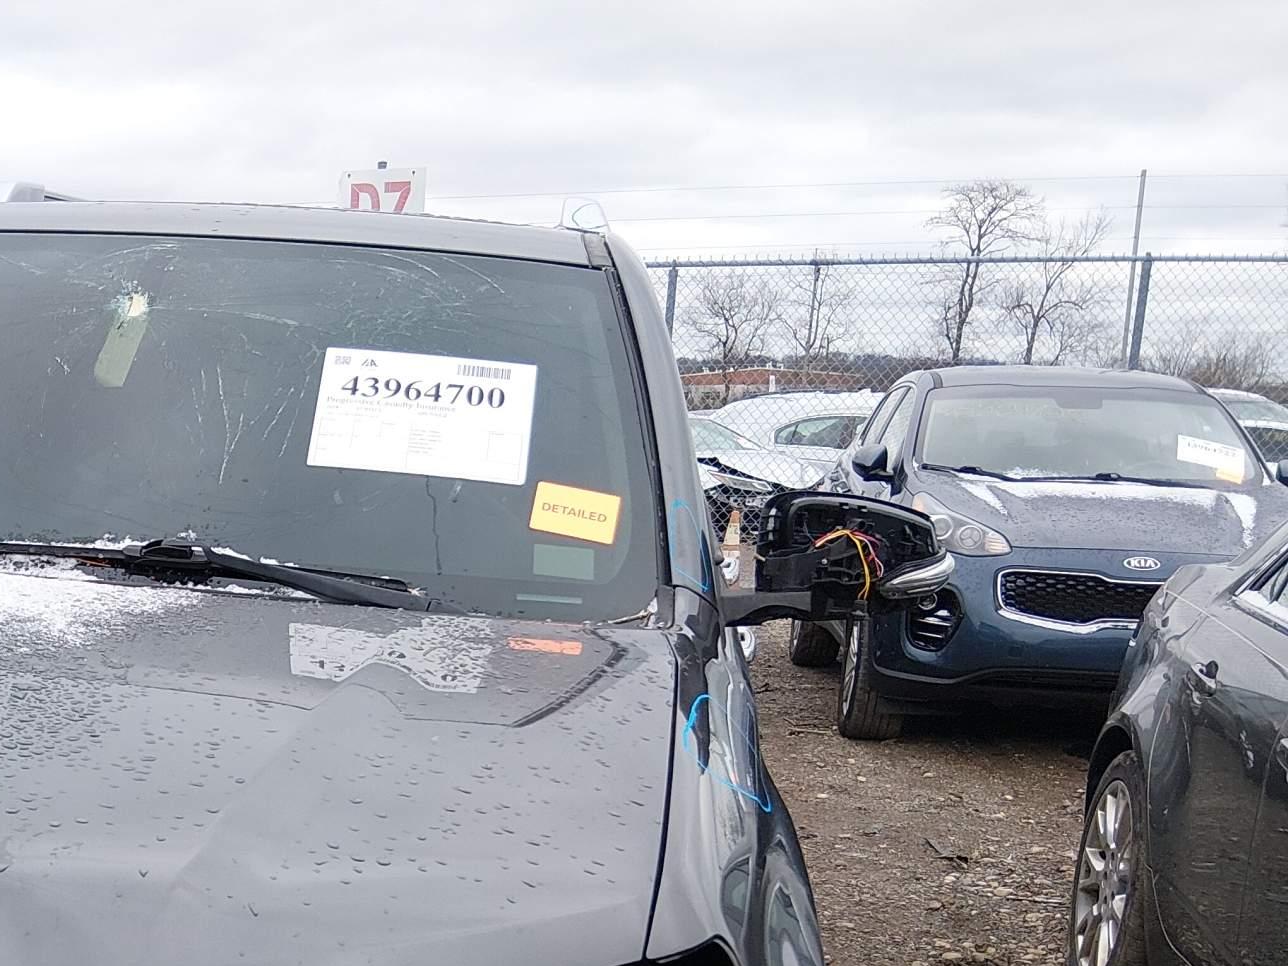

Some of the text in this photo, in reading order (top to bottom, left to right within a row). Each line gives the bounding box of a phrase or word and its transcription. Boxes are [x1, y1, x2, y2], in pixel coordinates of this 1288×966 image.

[350, 181, 412, 214] D7
[341, 374, 506, 409] 43964700
[541, 501, 608, 524] DETAILED
[1130, 558, 1155, 567] KIA
